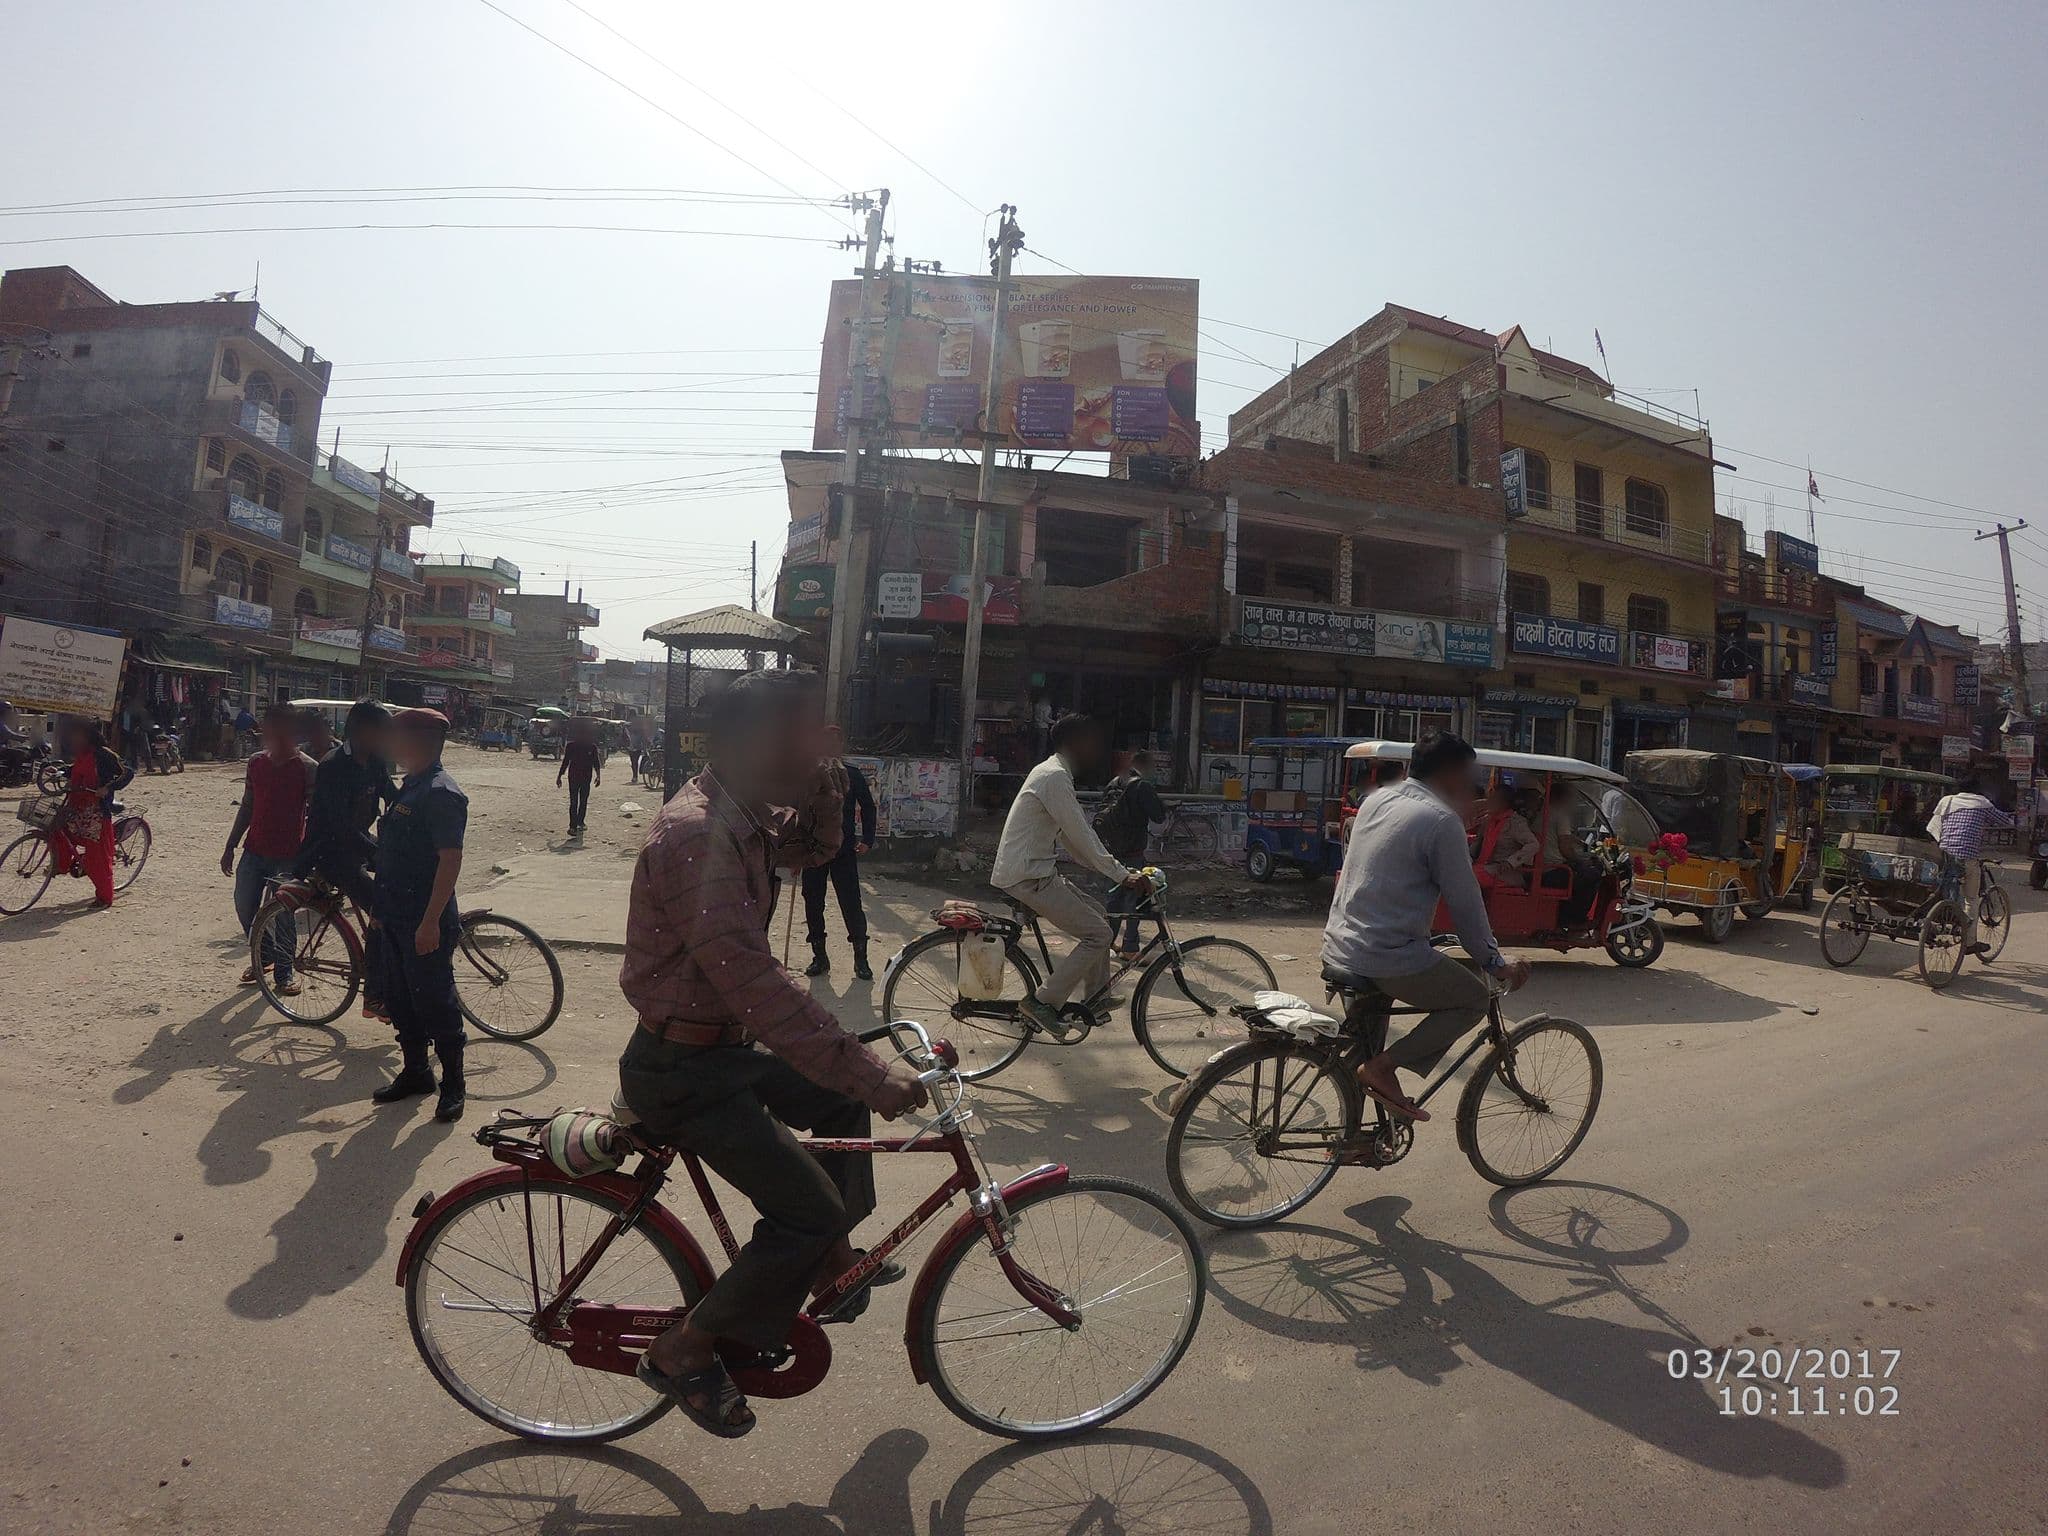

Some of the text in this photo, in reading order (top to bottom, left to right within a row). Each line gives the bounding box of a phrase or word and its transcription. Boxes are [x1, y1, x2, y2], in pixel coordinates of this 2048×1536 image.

[1009, 294, 1036, 302] BLAZE
[1079, 305, 1100, 313] AND
[1103, 306, 1137, 314] POWER
[1515, 618, 1616, 654] लक्ष्मी होटल एण्ड लज
